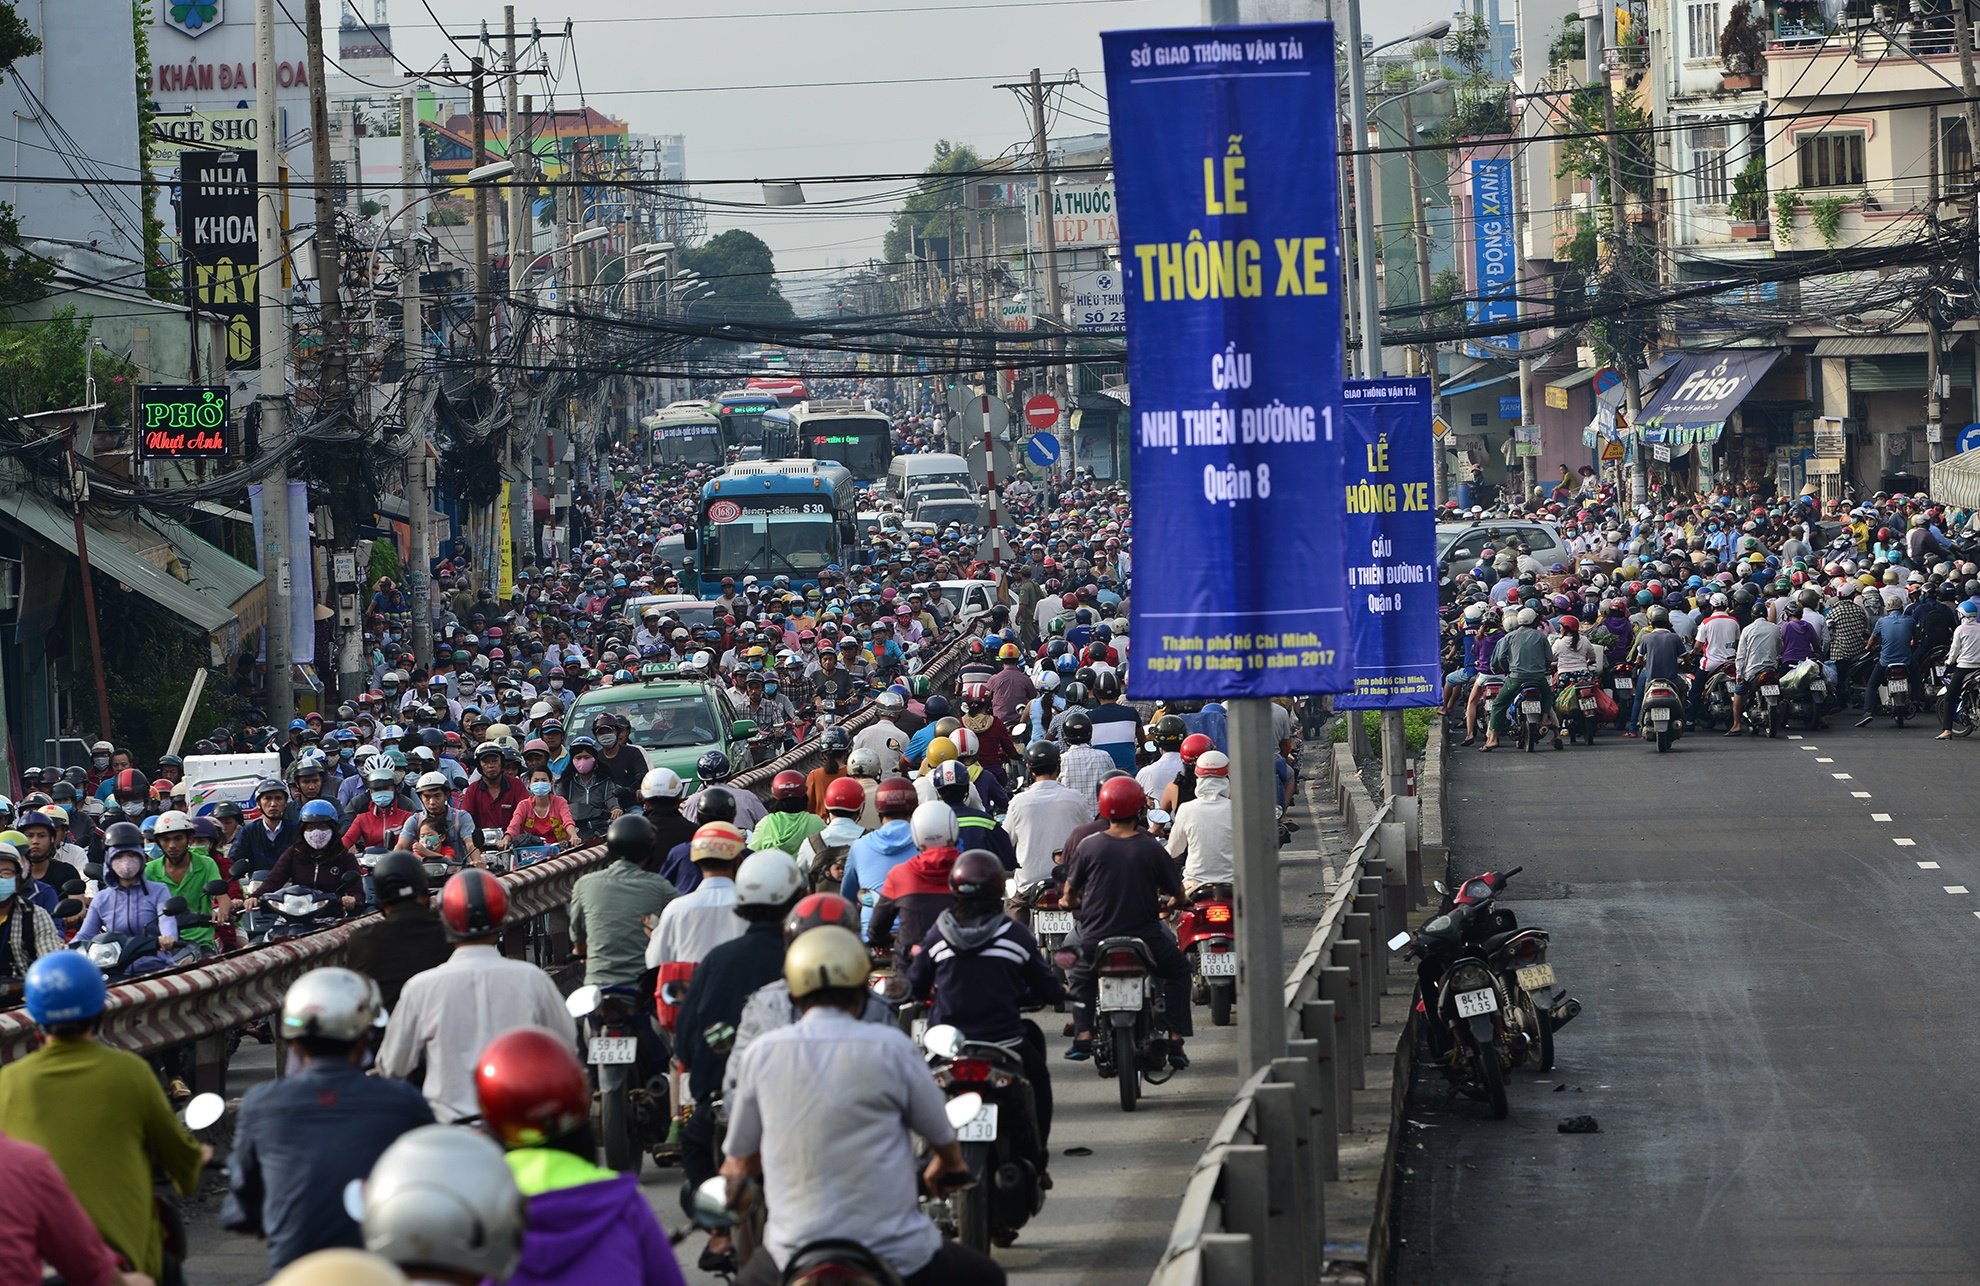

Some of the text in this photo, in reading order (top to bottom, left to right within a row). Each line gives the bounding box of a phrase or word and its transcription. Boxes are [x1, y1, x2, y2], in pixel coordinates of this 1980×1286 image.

[339, 45, 391, 60] HOTEL
[1131, 36, 1303, 67] SỞ GIAO THÔNG VẬN TẢI
[159, 56, 213, 91] KHÁM
[218, 62, 247, 90] ĐA
[1203, 134, 1248, 215] LỄ
[1065, 184, 1111, 215] THUỐC
[1479, 165, 1501, 216] XANH
[194, 215, 257, 244] KHOA
[1482, 221, 1508, 275] ĐỘNG
[1134, 229, 1328, 302] THÔNG XE
[196, 256, 259, 304] TÂY
[1076, 291, 1099, 309] HIỆU
[1084, 308, 1105, 323] SỐ
[1211, 340, 1252, 391] CẦU
[1344, 384, 1417, 399] GIAO THÔNG VẬN TẢI
[145, 391, 224, 428] PHỞ
[654, 429, 664, 440] 47
[1141, 398, 1333, 455] NHỊ THIÊN ĐƯỜNG 1
[187, 431, 223, 450] Anh
[1366, 432, 1389, 472] LỄ
[1203, 462, 1271, 508] Quận 8
[1402, 482, 1429, 512] XE
[1371, 533, 1392, 558] CẦU
[1357, 563, 1385, 586] THIÊN
[1387, 561, 1424, 585] ĐƯỜNG
[1426, 564, 1432, 583] 1
[1367, 593, 1402, 615] Quận 8
[1162, 634, 1203, 651] Thành
[1255, 632, 1279, 649] Chí
[1281, 631, 1322, 649] Minh,
[1147, 650, 1335, 672] ngày 19 tháng 10 năm 2017
[1360, 687, 1369, 695] 19
[1370, 686, 1388, 696] tháng
[1390, 686, 1399, 694] 10
[1400, 685, 1416, 694] năm
[1416, 684, 1434, 693] 2017
[1394, 676, 1406, 685] Chí
[1407, 675, 1427, 684] Minh,
[1042, 922, 1071, 932] 440.40
[1204, 964, 1235, 974] 169.48
[1461, 991, 1488, 1005] 84-K4
[597, 1040, 628, 1051] 59-P1
